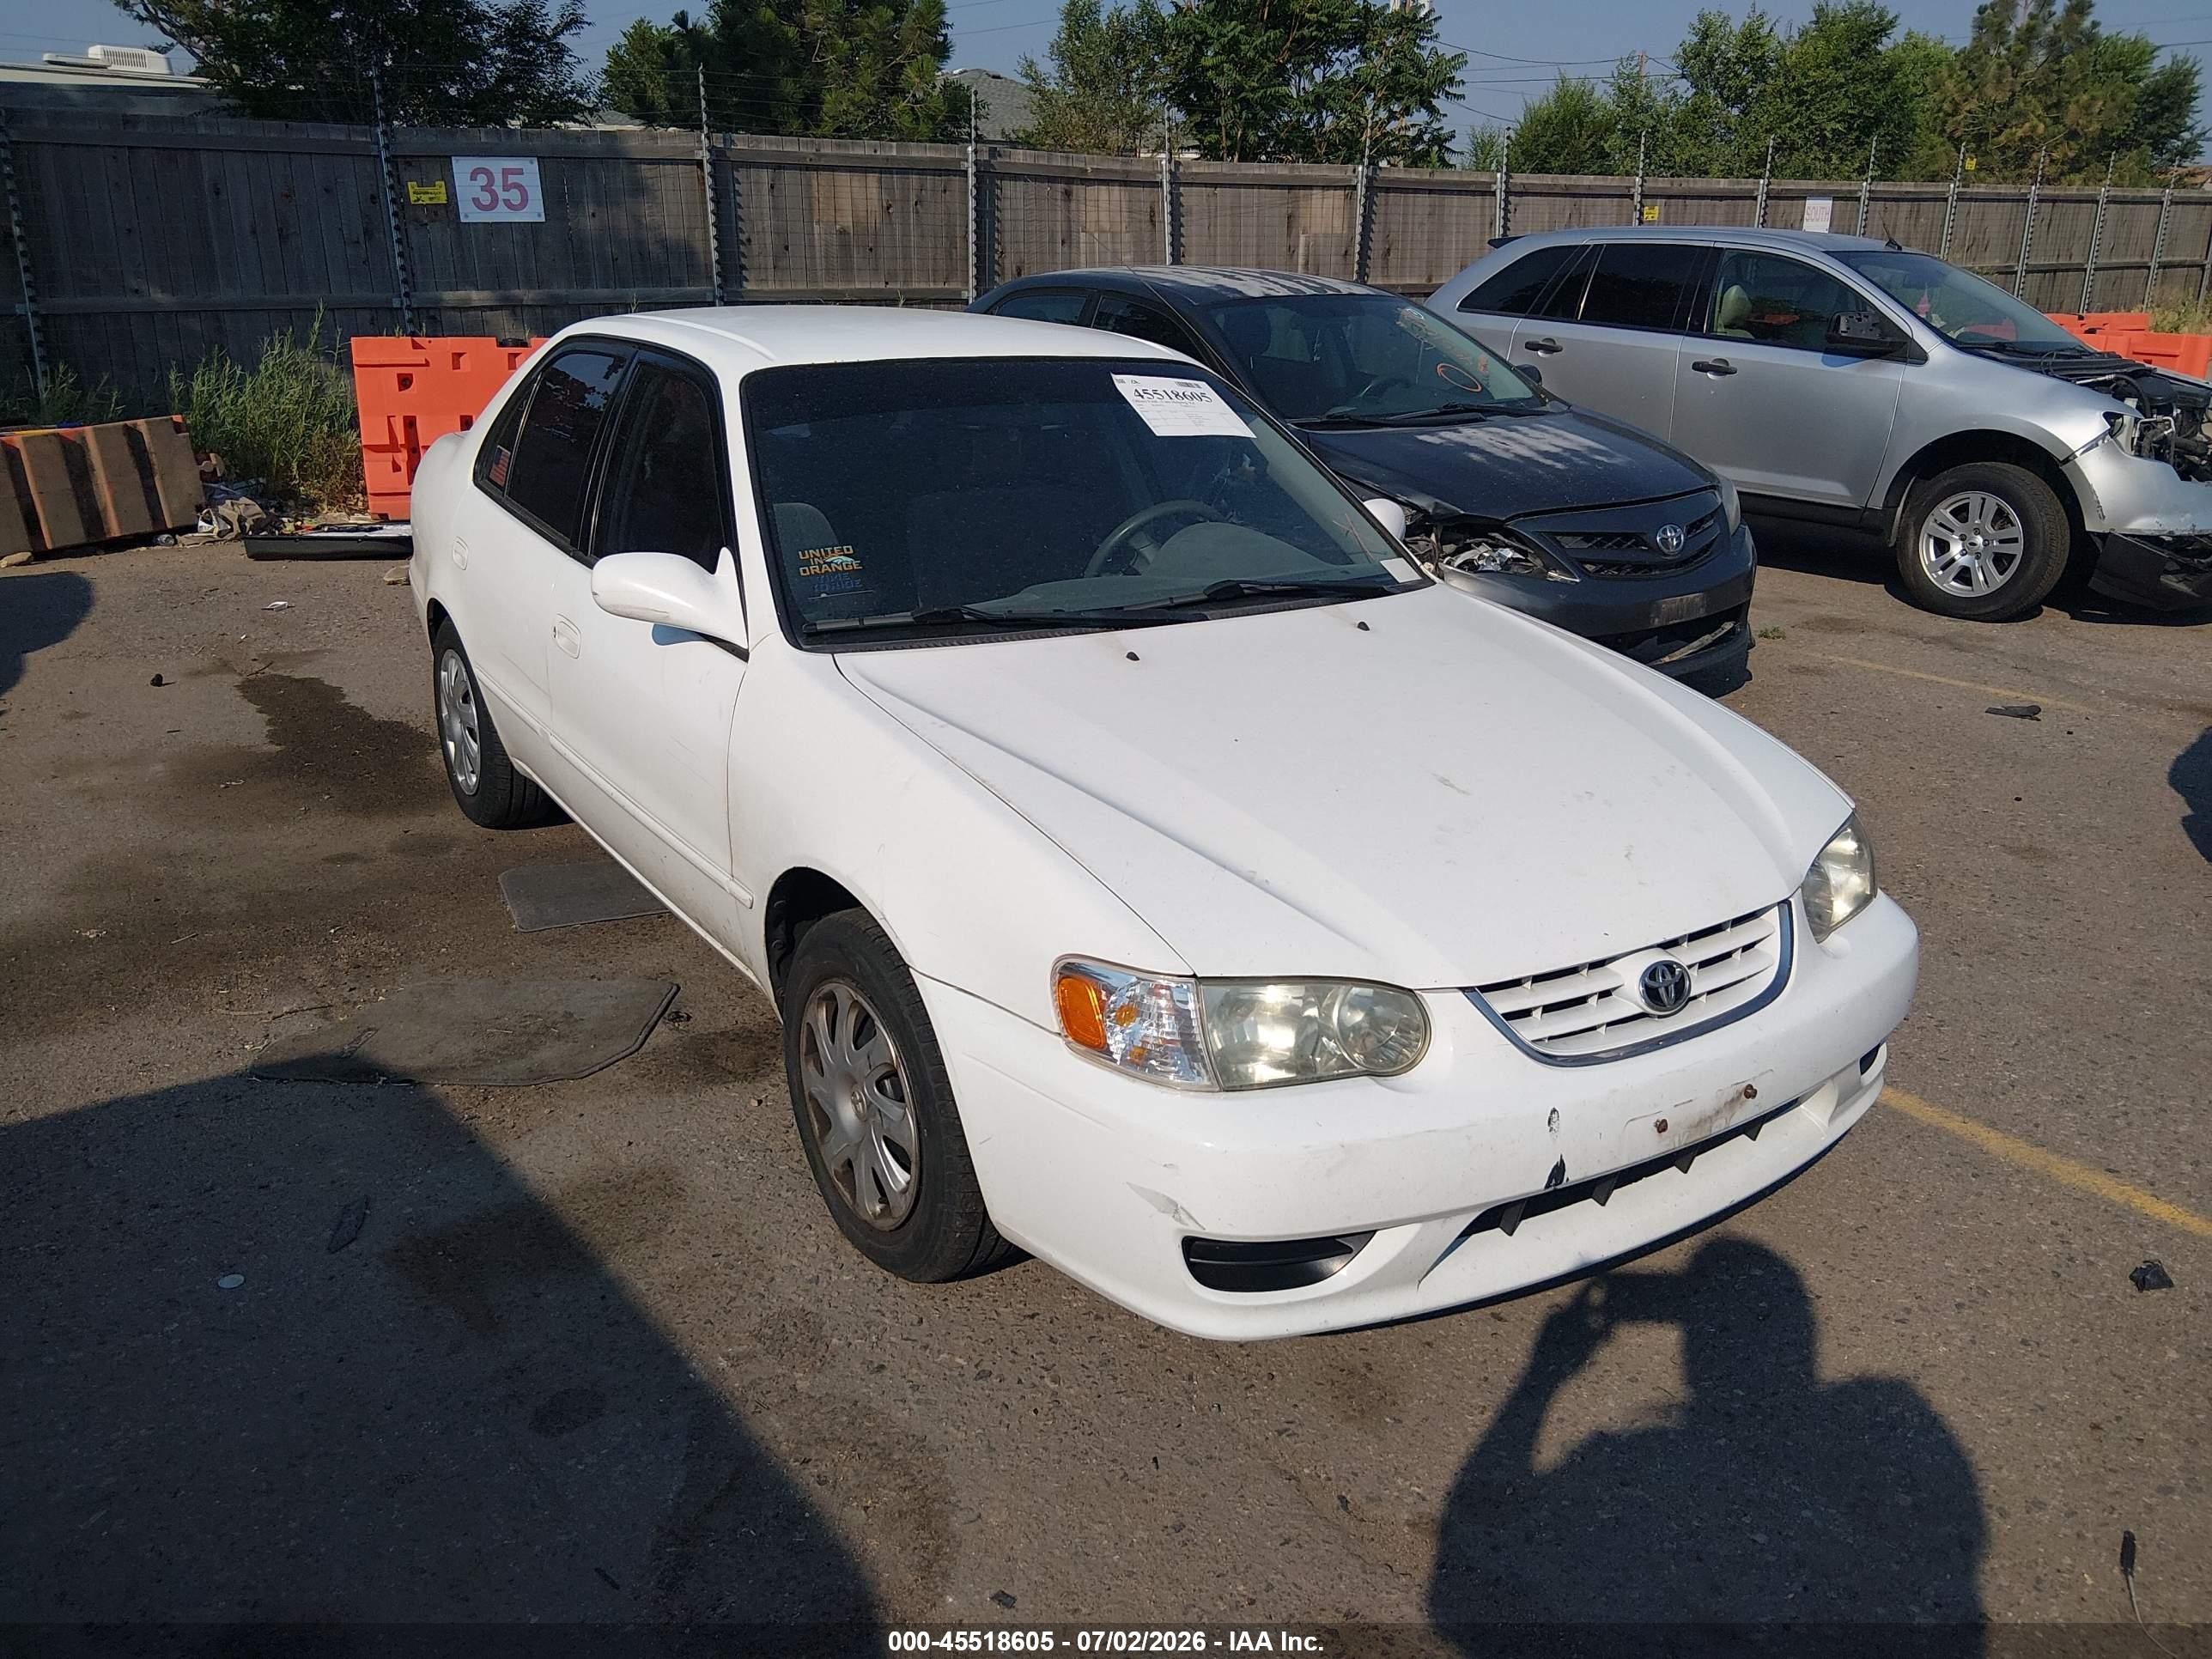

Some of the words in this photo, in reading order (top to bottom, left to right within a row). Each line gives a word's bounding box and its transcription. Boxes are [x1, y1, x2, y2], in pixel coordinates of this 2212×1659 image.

[470, 167, 528, 211] 35
[1806, 206, 1830, 221] SOUTH
[1133, 388, 1212, 403] 45518605
[799, 545, 854, 559] UNITED
[799, 561, 863, 575] ORANGE
[811, 557, 824, 566] IN
